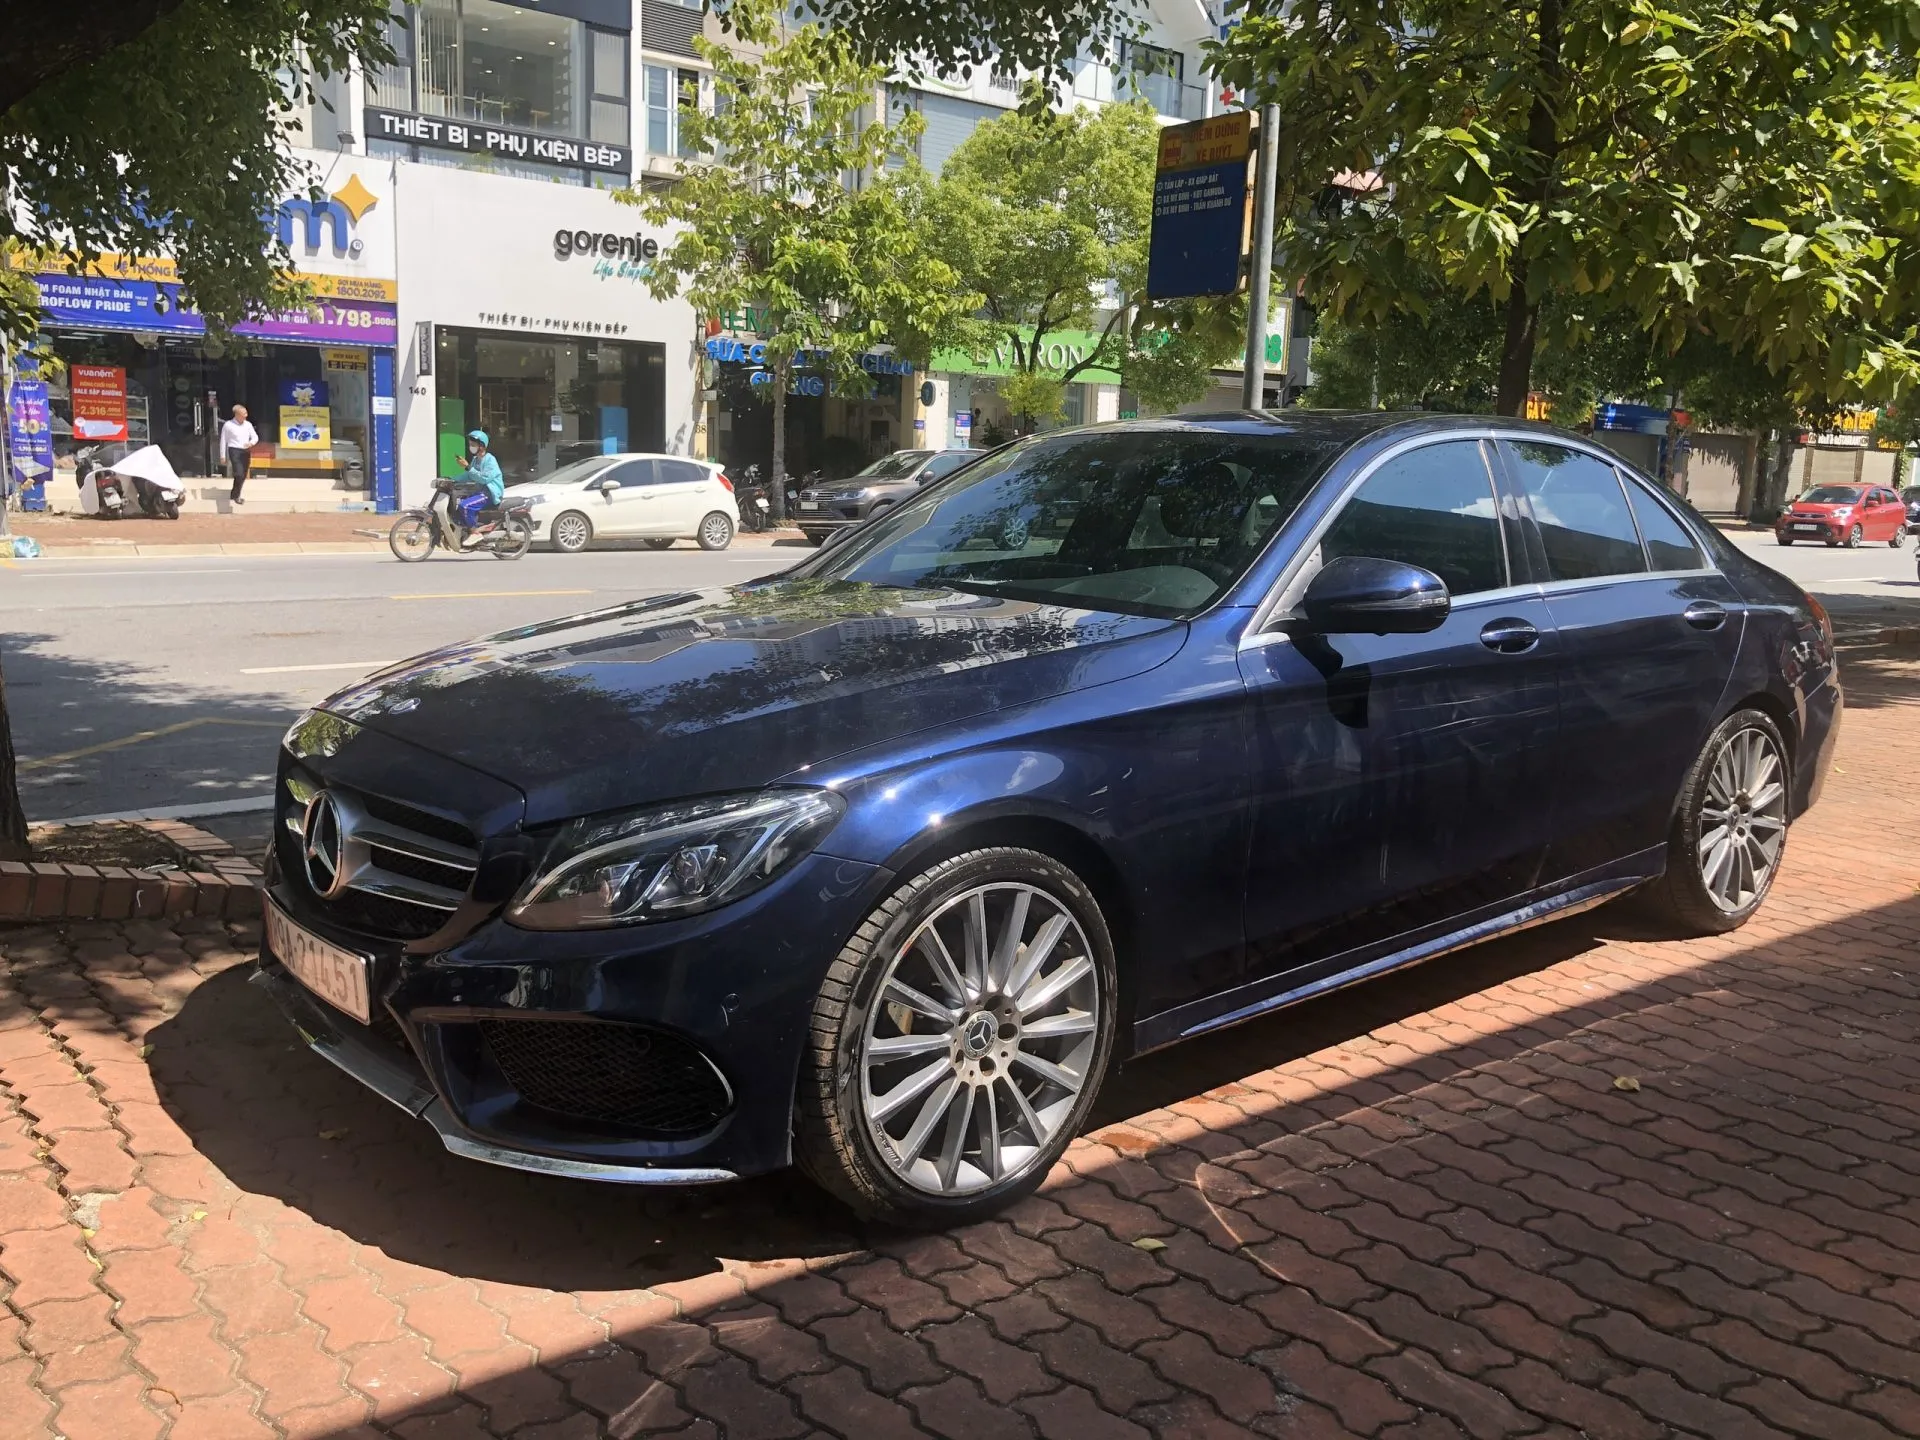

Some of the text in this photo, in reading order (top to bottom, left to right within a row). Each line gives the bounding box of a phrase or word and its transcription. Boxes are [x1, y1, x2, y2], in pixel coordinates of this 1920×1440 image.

[380, 113, 442, 140] THIẾT
[448, 125, 469, 149] BỊ
[486, 131, 528, 157] PHỤ
[533, 138, 579, 163] KIỆN
[583, 144, 622, 168] BẾP
[555, 229, 658, 263] gorenje
[52, 283, 81, 297] FOAM
[84, 285, 110, 300] NHẬT
[337, 287, 386, 299] 1800.2092
[95, 299, 131, 313] PRIDE
[479, 311, 517, 326] THIẾT
[521, 316, 532, 330] BỊ
[544, 318, 570, 333] PHỤ
[573, 320, 601, 334] KIỆN
[605, 321, 628, 336] BẾP
[408, 386, 427, 396] 140
